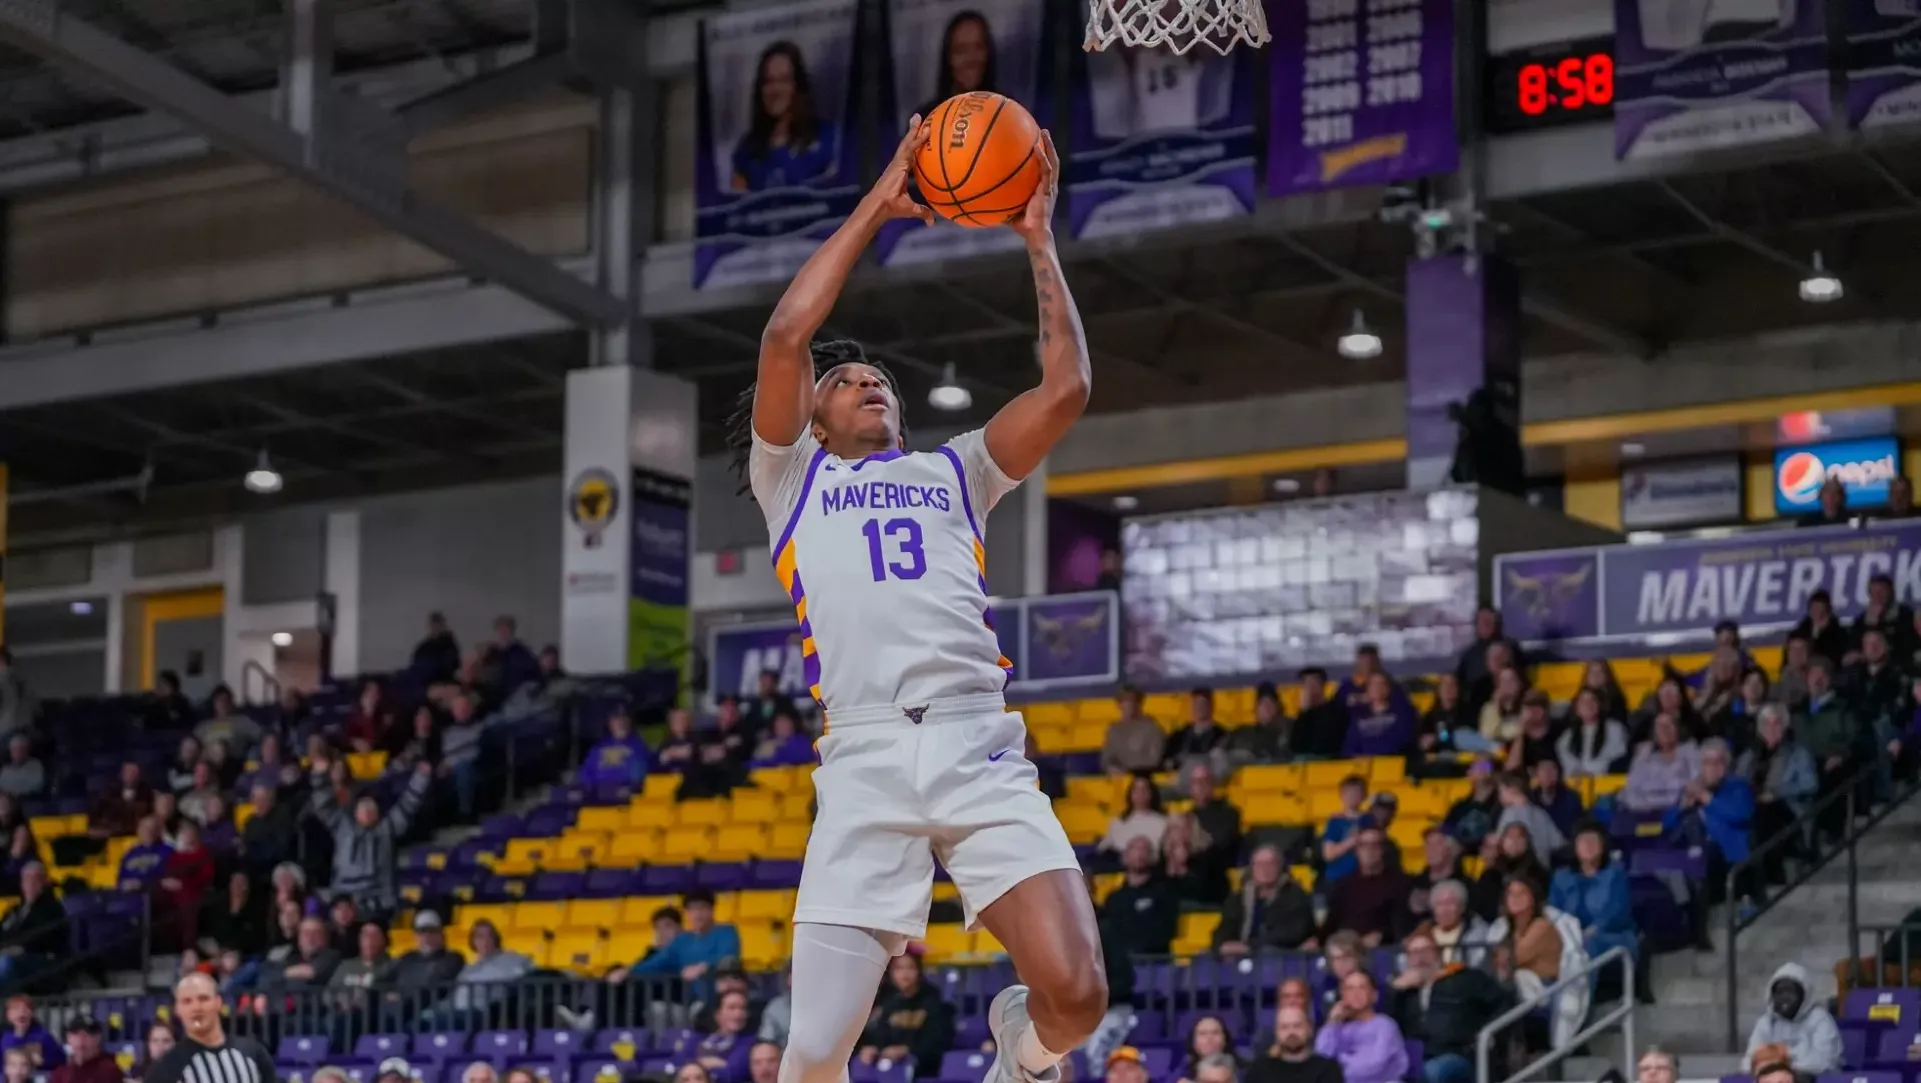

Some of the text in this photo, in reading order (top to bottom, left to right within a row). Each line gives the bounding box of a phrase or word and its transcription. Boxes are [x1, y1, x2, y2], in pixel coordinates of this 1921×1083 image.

[1518, 53, 1614, 115] 8:58
[821, 482, 950, 516] MAVERICKS
[862, 517, 927, 582] 13
